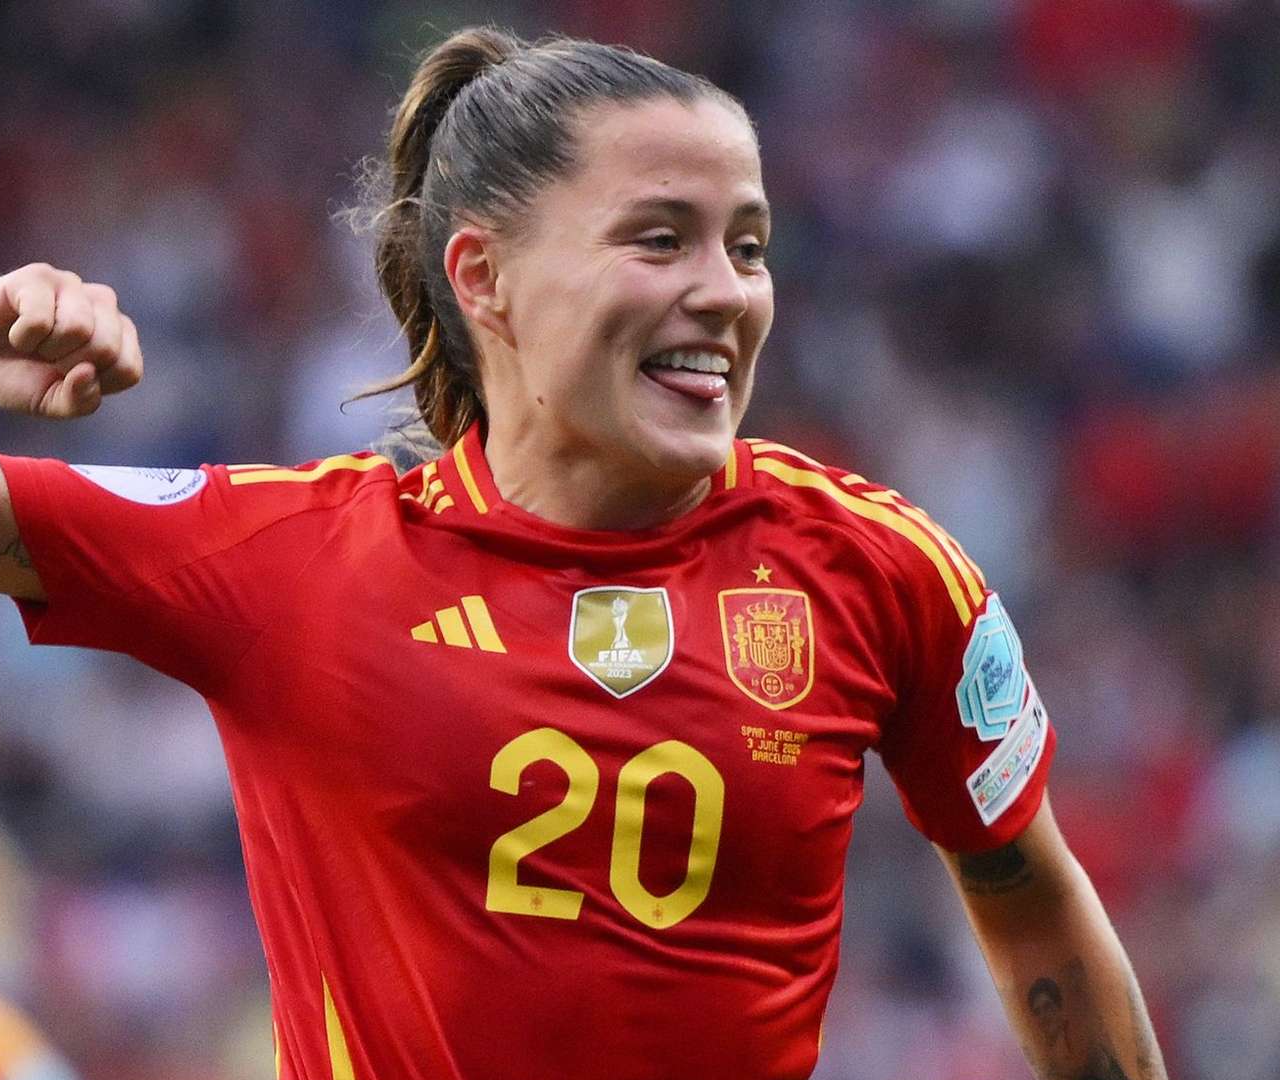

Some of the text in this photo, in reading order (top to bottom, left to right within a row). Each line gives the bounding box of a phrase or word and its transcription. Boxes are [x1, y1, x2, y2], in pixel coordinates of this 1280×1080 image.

[597, 649, 644, 664] FIFA
[740, 725, 766, 739] SPAIN
[746, 737, 754, 749] 3
[757, 739, 779, 752] JUNE
[751, 749, 798, 767] BARCELONA
[486, 727, 725, 930] 20
